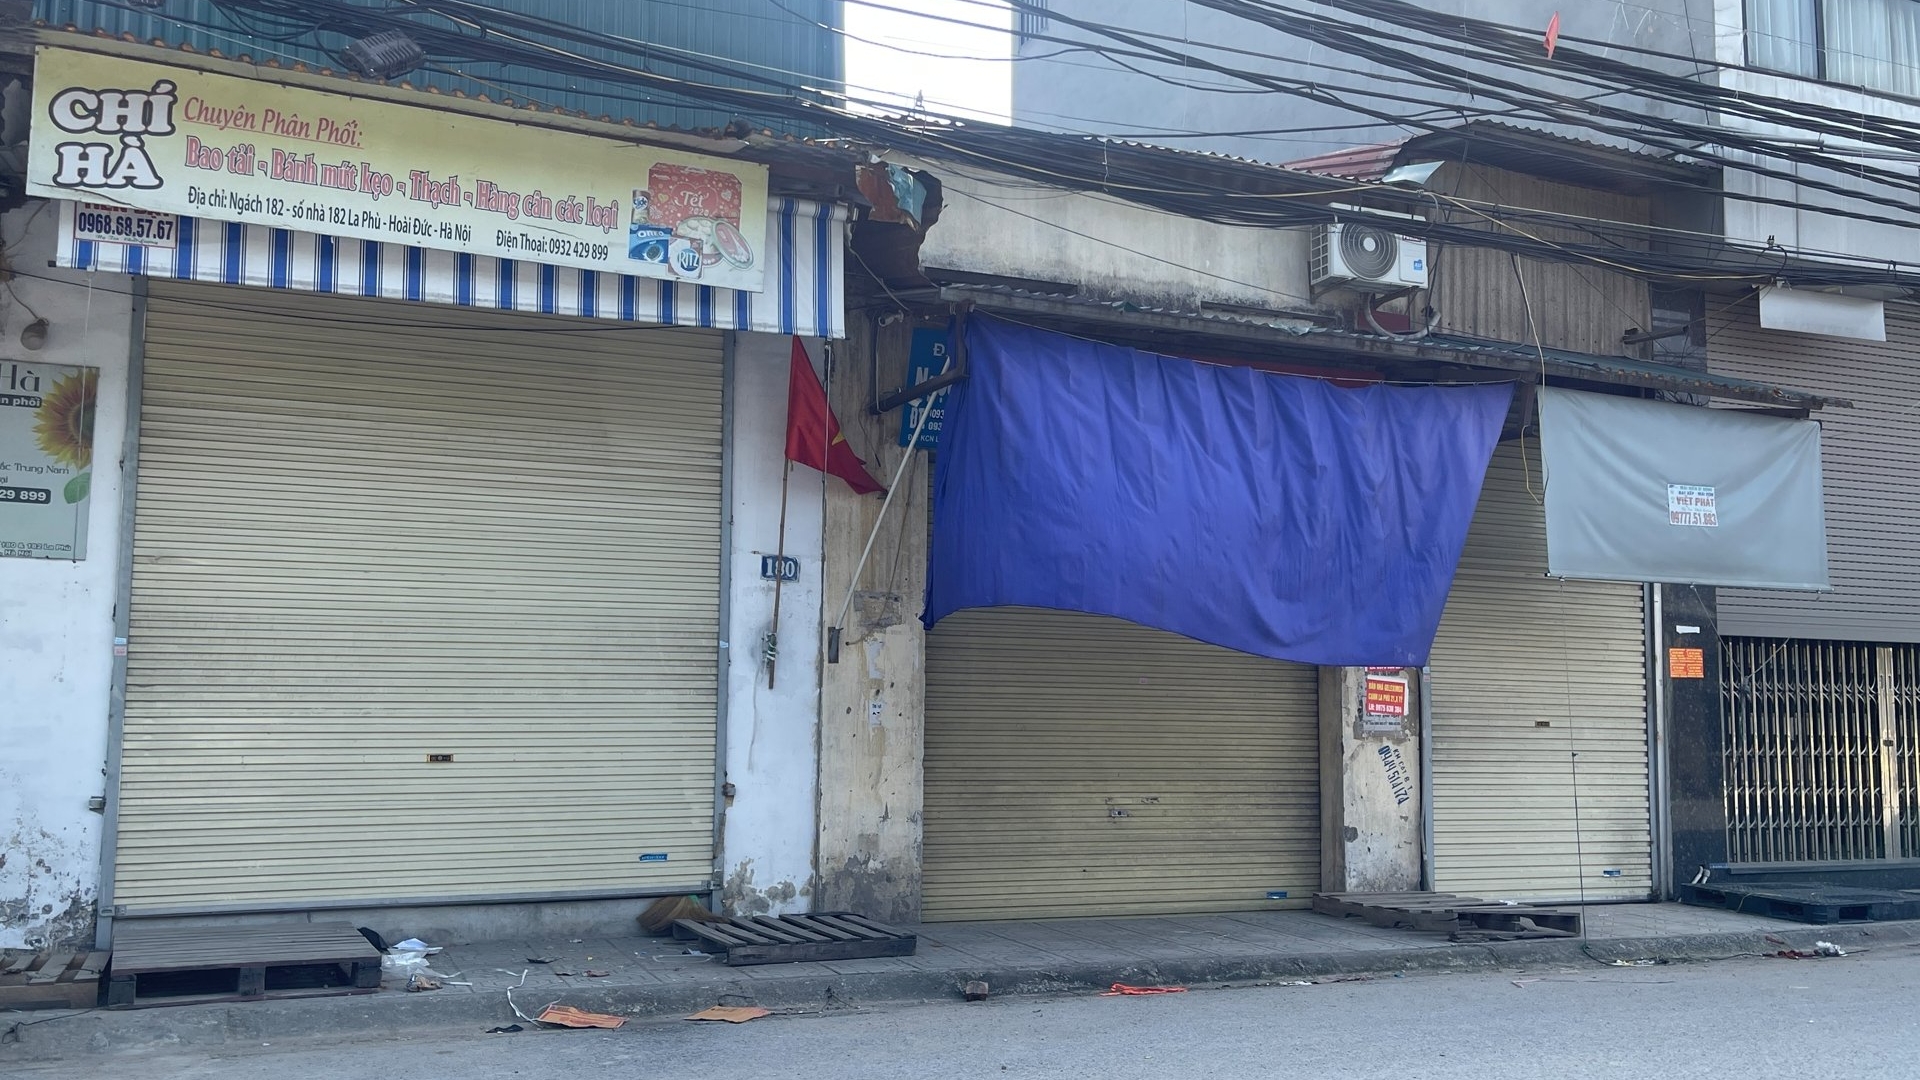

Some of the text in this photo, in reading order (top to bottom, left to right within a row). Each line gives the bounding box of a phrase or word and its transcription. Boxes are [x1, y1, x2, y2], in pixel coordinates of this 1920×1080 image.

[49, 79, 178, 137] CHÍ
[184, 96, 363, 147] Chuyên Phân Phối:
[52, 133, 164, 189] HÀ
[185, 135, 223, 171] Bao
[226, 143, 255, 176] tải
[270, 148, 317, 186] Bánh
[320, 161, 357, 191] mứt
[359, 162, 393, 201] kẹo
[409, 170, 461, 209] Thạch
[475, 180, 520, 220] Hàng
[522, 190, 552, 220] cân
[555, 195, 584, 224] các
[585, 196, 619, 234] loại
[78, 211, 174, 240] 0968.68.57.67
[188, 186, 206, 209] Địa
[208, 189, 227, 208] chỉ:
[229, 191, 262, 215] Ngách
[266, 198, 283, 216] 182
[292, 199, 304, 218] số
[306, 203, 325, 222] nhà
[328, 207, 346, 225] 182
[348, 208, 359, 227] La
[361, 211, 381, 230] Phù
[388, 214, 411, 234] Hoài
[413, 218, 432, 237] Đức
[440, 221, 452, 239] Hà
[454, 223, 471, 246] Nội
[688, 206, 709, 217] 2020
[496, 229, 609, 261] Điện Thoại: 0932 429 899
[677, 252, 700, 269] RITZ
[12, 396, 41, 407] phối
[14, 462, 44, 474] Trung
[46, 465, 70, 475] Nam
[0, 489, 47, 501] 29 899
